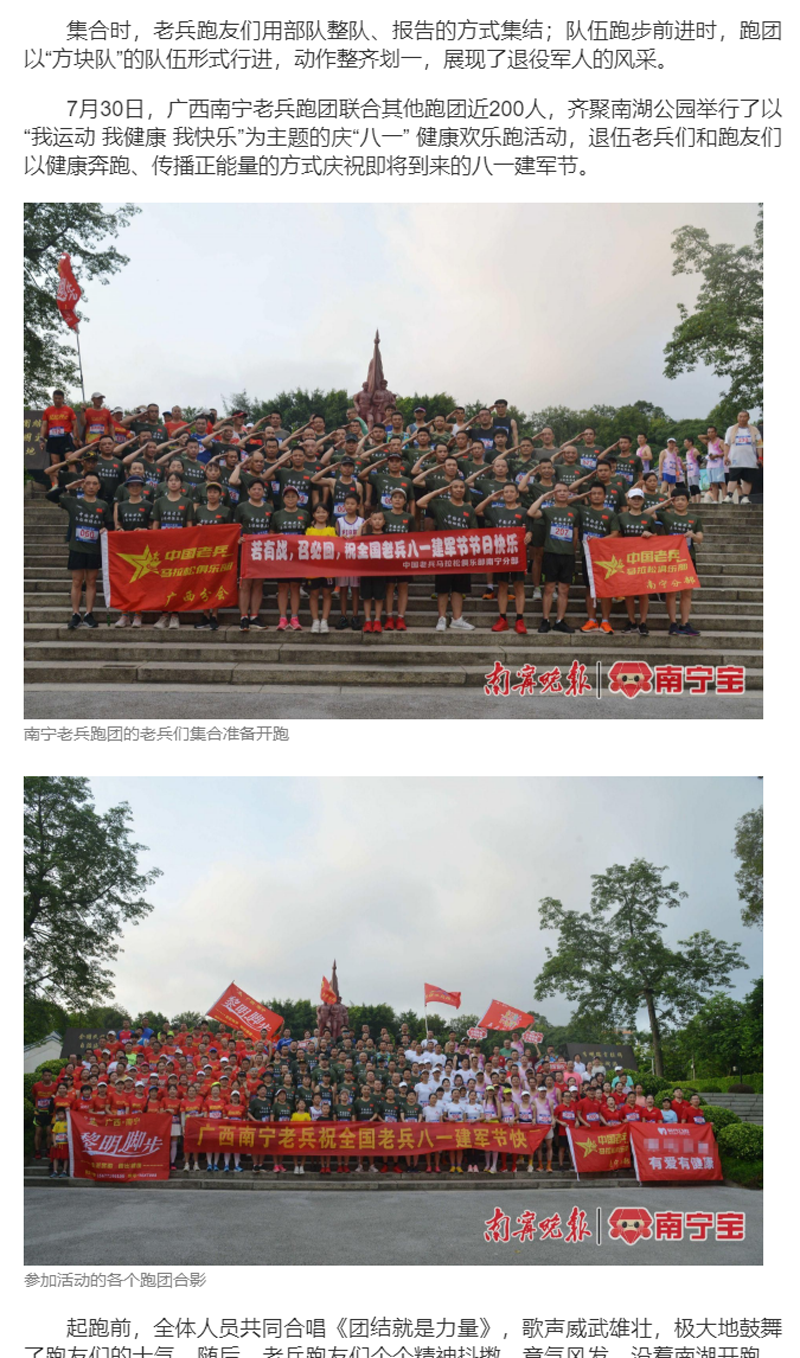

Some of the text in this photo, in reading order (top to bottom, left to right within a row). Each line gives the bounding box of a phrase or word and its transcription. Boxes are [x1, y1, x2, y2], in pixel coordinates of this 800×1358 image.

[102, 126, 166, 148] 我健康
[164, 544, 234, 562] 中国老兵
[626, 549, 687, 565] 中国老兵
[160, 562, 234, 578] 马拉松俱乐部
[24, 726, 289, 742] 南宁老兵跑团的老兵们集合准备开跑
[80, 1129, 164, 1157] 黎明脚步
[197, 1124, 540, 1150] 广西南宁老兵祝全国老兵八一建军节快
[648, 1156, 715, 1171] 有爱有健康
[24, 1273, 206, 1288] 参加活动的各个跑团合影
